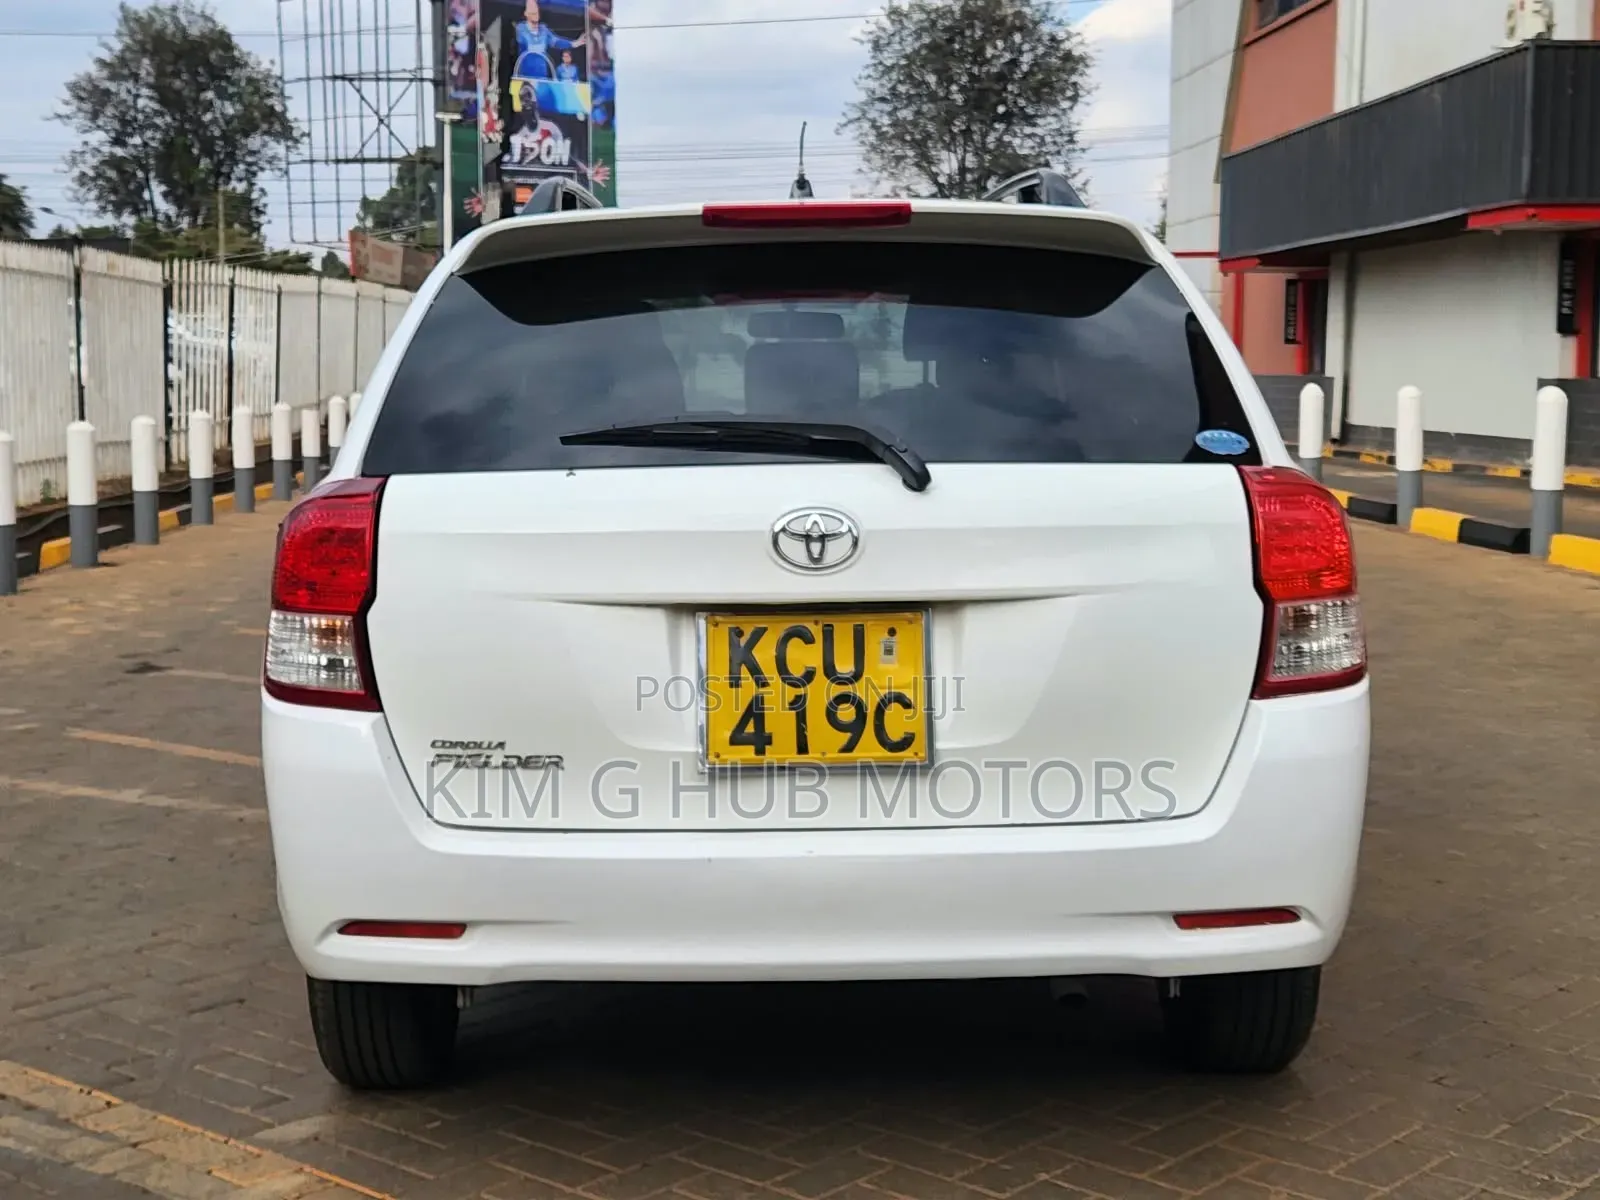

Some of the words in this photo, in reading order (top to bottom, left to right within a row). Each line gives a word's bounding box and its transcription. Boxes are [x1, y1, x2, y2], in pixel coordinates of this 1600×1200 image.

[728, 624, 866, 689] KCU
[728, 691, 917, 756] 419C
[430, 740, 506, 750] COROLLA
[430, 753, 565, 771] FIELDER
